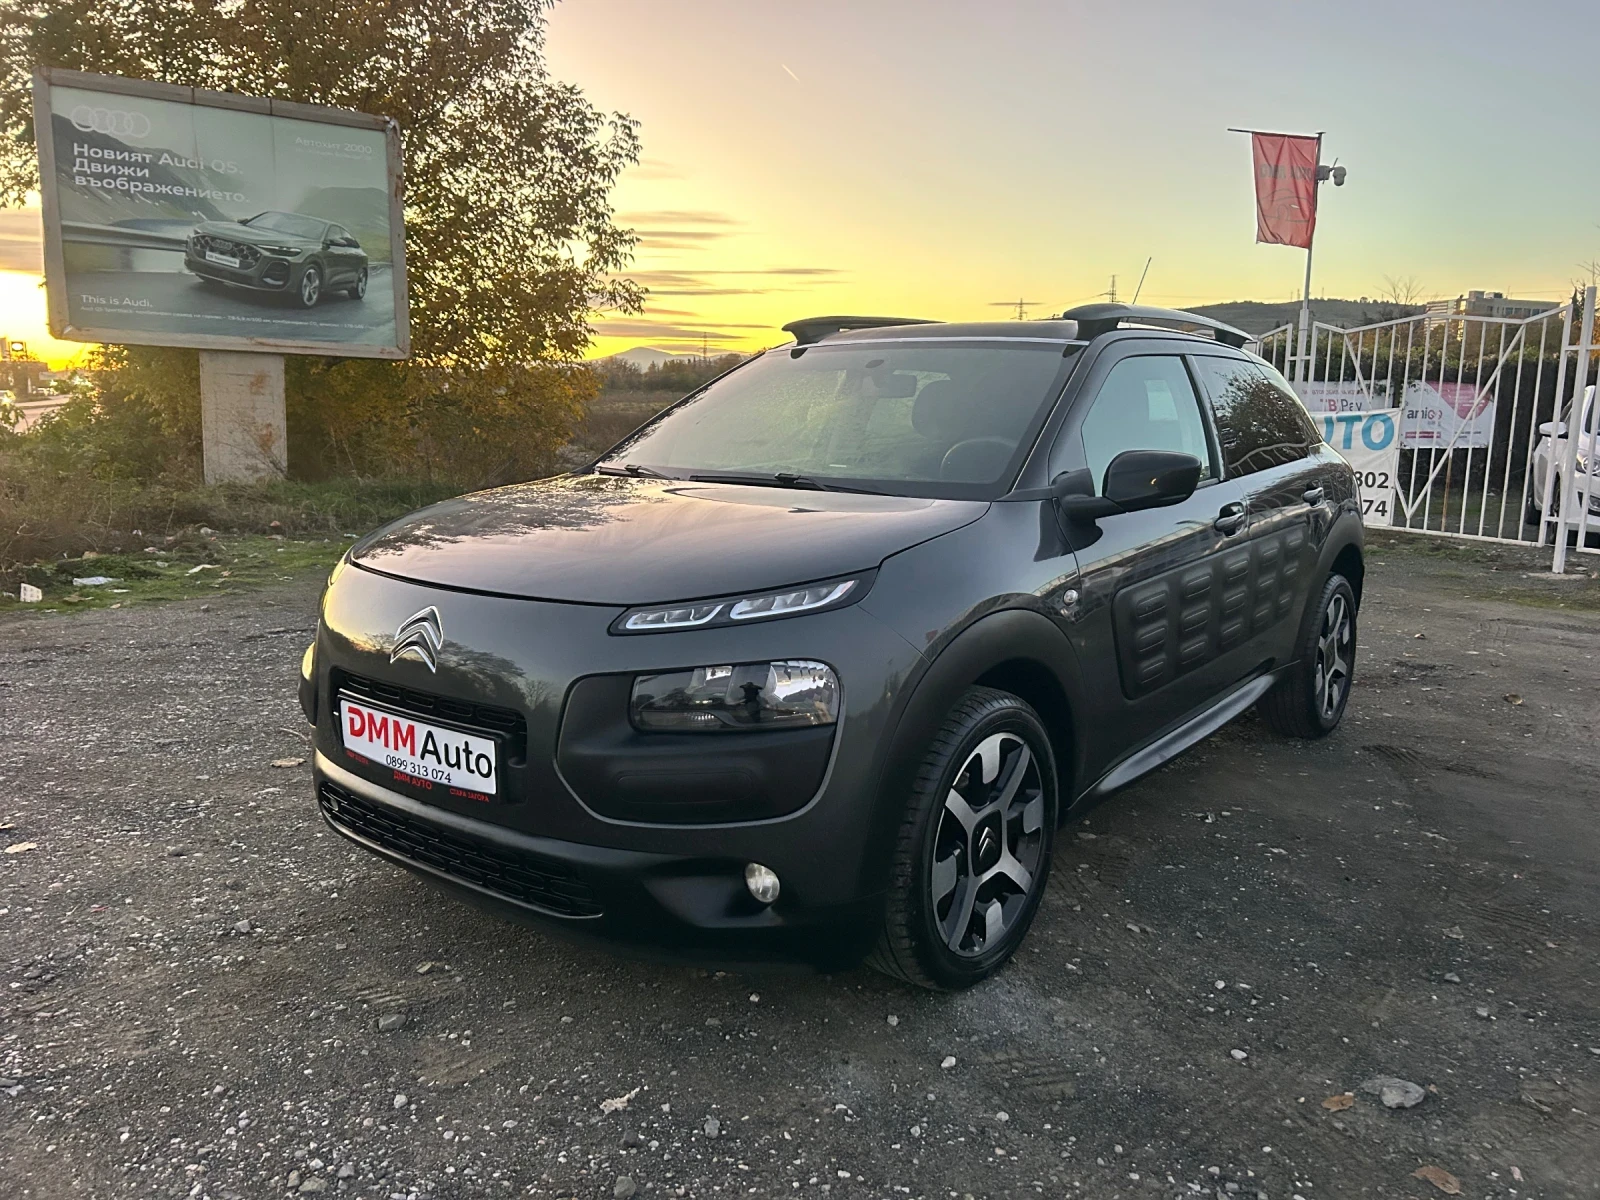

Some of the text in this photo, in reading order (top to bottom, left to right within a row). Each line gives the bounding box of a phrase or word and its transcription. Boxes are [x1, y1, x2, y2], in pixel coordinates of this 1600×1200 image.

[344, 142, 372, 154] 2000
[73, 142, 243, 174] Новият Audi Q5.
[73, 158, 150, 178] Движи
[75, 175, 250, 202] въображението.
[80, 294, 153, 307] This is Audi.
[1362, 499, 1388, 517] 74
[386, 754, 408, 771] 0899
[410, 763, 429, 777] 313
[431, 768, 452, 784] 074
[411, 777, 433, 790] АУТО
